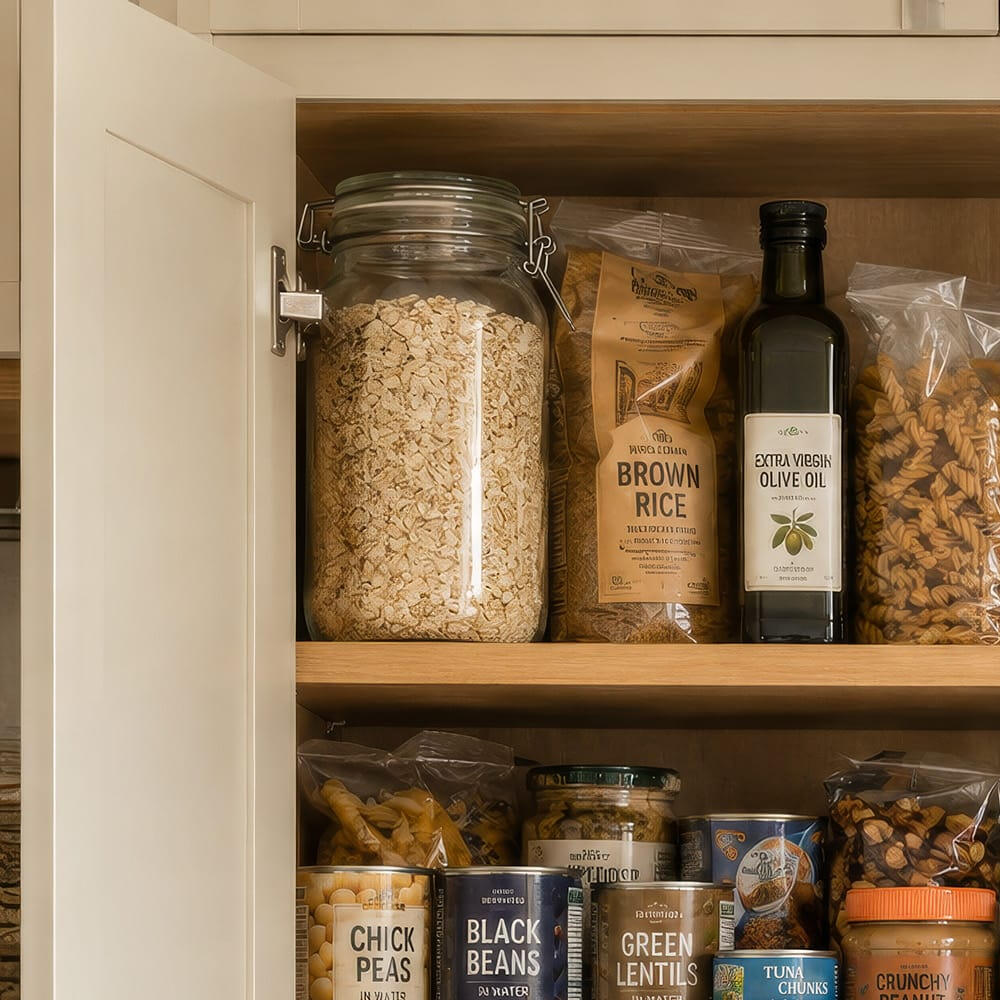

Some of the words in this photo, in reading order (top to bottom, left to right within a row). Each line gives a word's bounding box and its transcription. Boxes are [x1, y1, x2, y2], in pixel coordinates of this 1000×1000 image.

[755, 453, 791, 468] EXTRA
[617, 461, 700, 488] BROWN
[759, 471, 800, 488] OLIVE
[805, 471, 826, 488] OIL
[635, 492, 687, 518] RICE
[350, 925, 415, 952] CHICK
[467, 918, 541, 944] BLACK
[622, 932, 693, 957] GREEN
[356, 956, 411, 983] PEAS
[467, 949, 541, 976] BEANS
[617, 962, 698, 986] LENTILS
[763, 965, 804, 979] TUNA
[778, 981, 828, 995] CHUNKS
[876, 973, 950, 991] CRUNCHY
